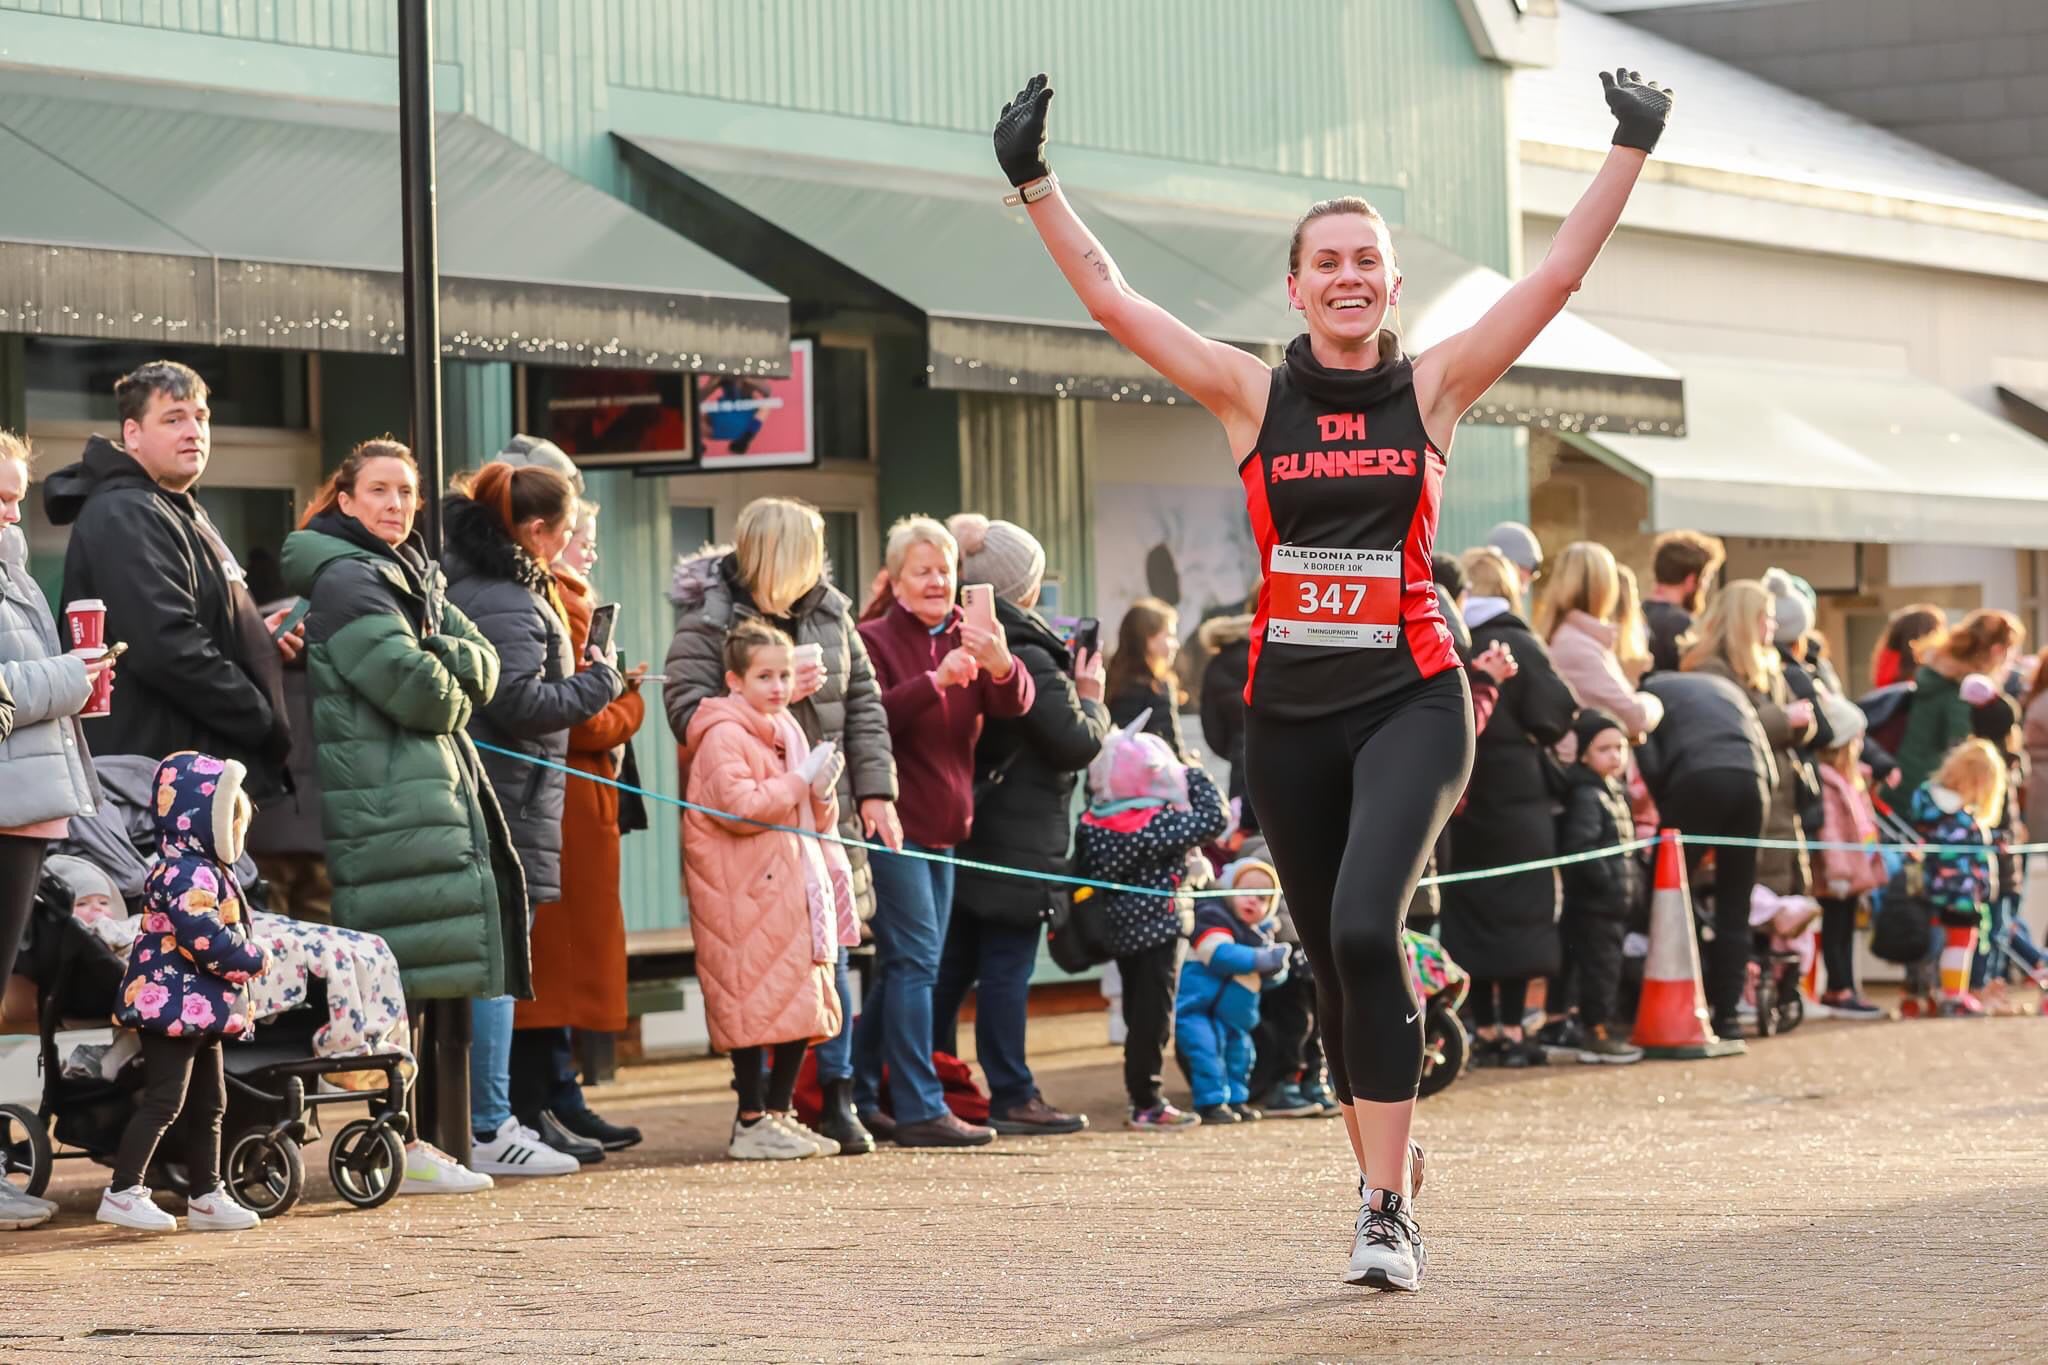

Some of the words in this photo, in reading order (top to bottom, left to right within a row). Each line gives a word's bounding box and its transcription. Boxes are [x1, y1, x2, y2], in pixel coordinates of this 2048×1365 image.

[1316, 412, 1366, 442] DH
[1271, 448, 1417, 484] RUNNERS
[1277, 549, 1352, 561] CALEDONIA
[1357, 552, 1393, 562] PARK
[1311, 563, 1345, 571] BORDER
[1348, 564, 1363, 572] 10K
[1297, 581, 1368, 616] 347
